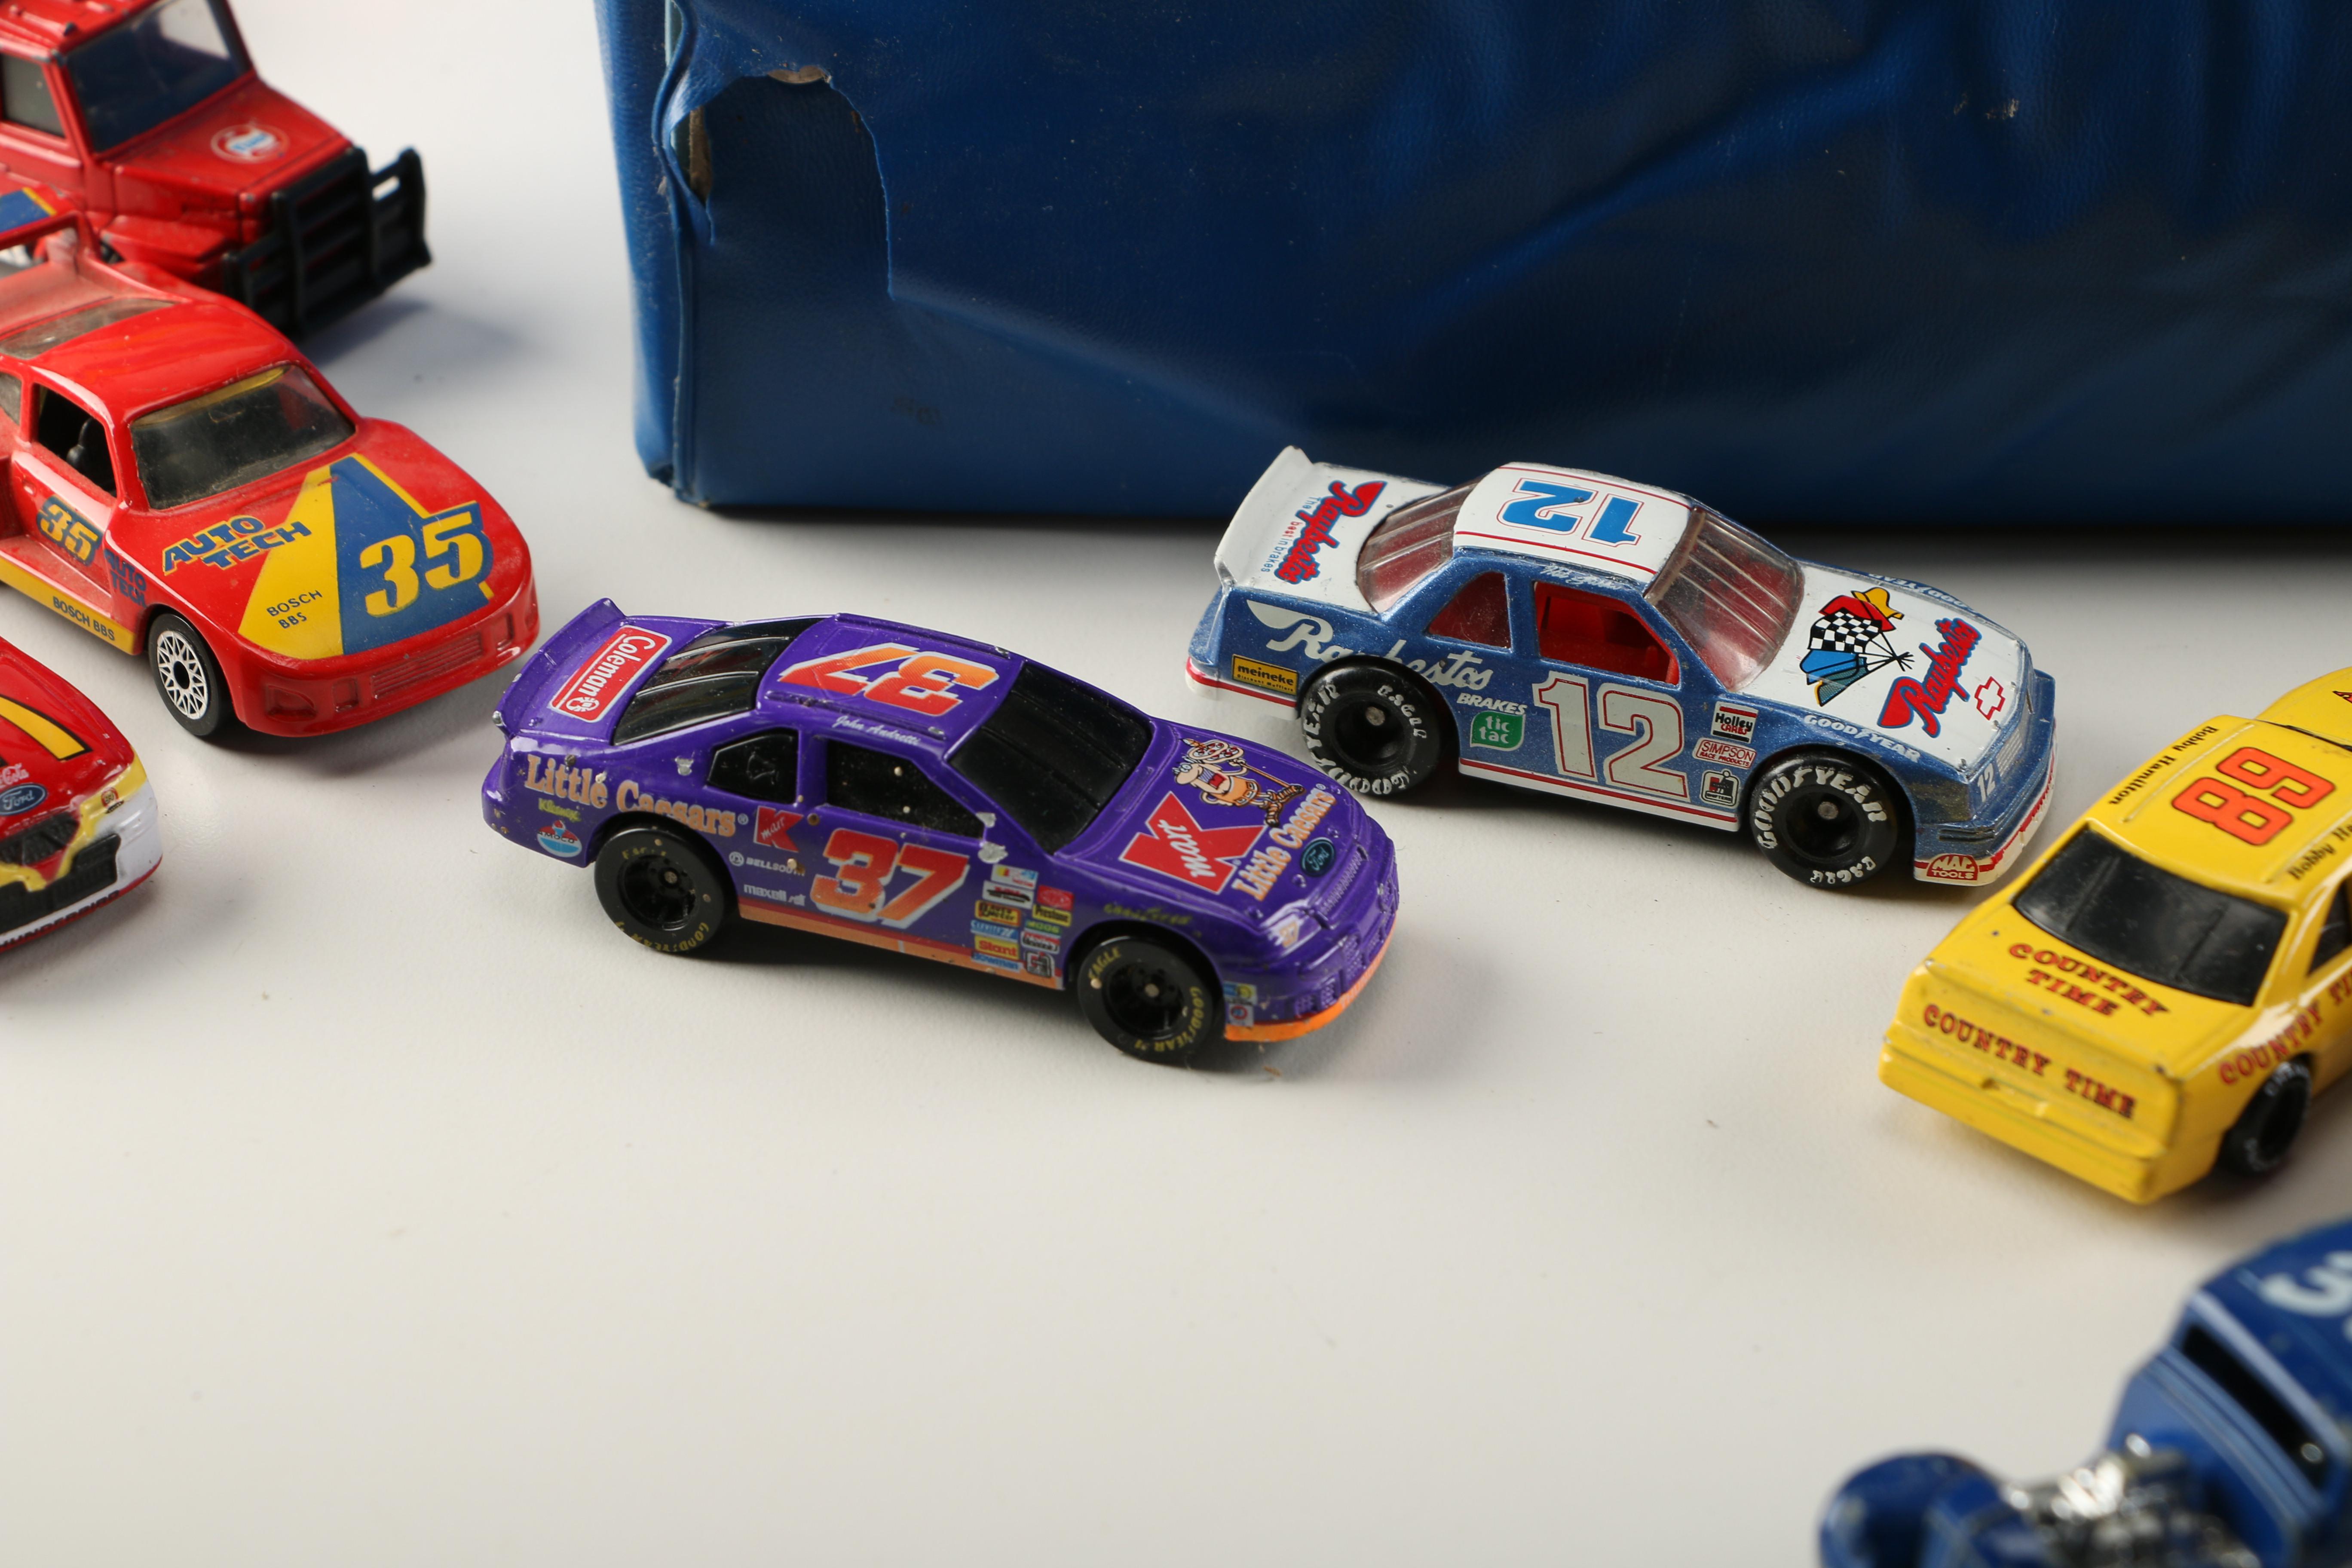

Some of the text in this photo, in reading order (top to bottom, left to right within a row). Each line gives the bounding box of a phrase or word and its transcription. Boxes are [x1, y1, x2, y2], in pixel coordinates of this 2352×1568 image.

[40, 504, 98, 561] 35
[1274, 481, 1387, 585] Raybestos
[1497, 478, 1644, 547] 12
[162, 515, 266, 576] AUTO
[202, 521, 312, 571] TECH
[360, 511, 483, 618] 35
[1261, 545, 1287, 573] brakes
[104, 548, 147, 592] AUTO
[1869, 573, 1975, 612] OODYEAR
[53, 596, 115, 641] BOSCH BBS
[266, 590, 323, 617] BOSCH
[278, 613, 308, 630] BBS
[578, 636, 655, 697] Coleman
[777, 643, 1000, 717] 37
[1238, 665, 1294, 686] meineke
[1456, 692, 1527, 715] BRAKES
[1485, 716, 1510, 732] tic
[1715, 713, 1753, 732] Holley
[1479, 726, 1509, 744] tac
[1532, 671, 1690, 802] 12
[1702, 741, 1754, 761] SIMPSON
[1804, 714, 1921, 763] GOODYEAR
[1700, 751, 1750, 766] RACE PRODUCTS
[2109, 726, 2219, 805] Bobby Hamilton
[2, 790, 35, 811] Ford
[524, 753, 736, 837] Little Caesars
[1977, 763, 1996, 802] 12
[2171, 747, 2336, 846] 89
[1231, 787, 1337, 902] Little Caesars
[1307, 847, 1329, 871] Ford
[1932, 855, 1975, 872] MAC
[2286, 842, 2337, 880] Bobby
[810, 828, 970, 929] 37
[1931, 870, 1974, 879] TOOLS
[2009, 943, 2169, 1016] COUNTRY
[2025, 968, 2121, 1016] TIME
[1923, 1004, 2136, 1119] COUNTRY TIME
[2218, 997, 2324, 1086] COUNTRY
